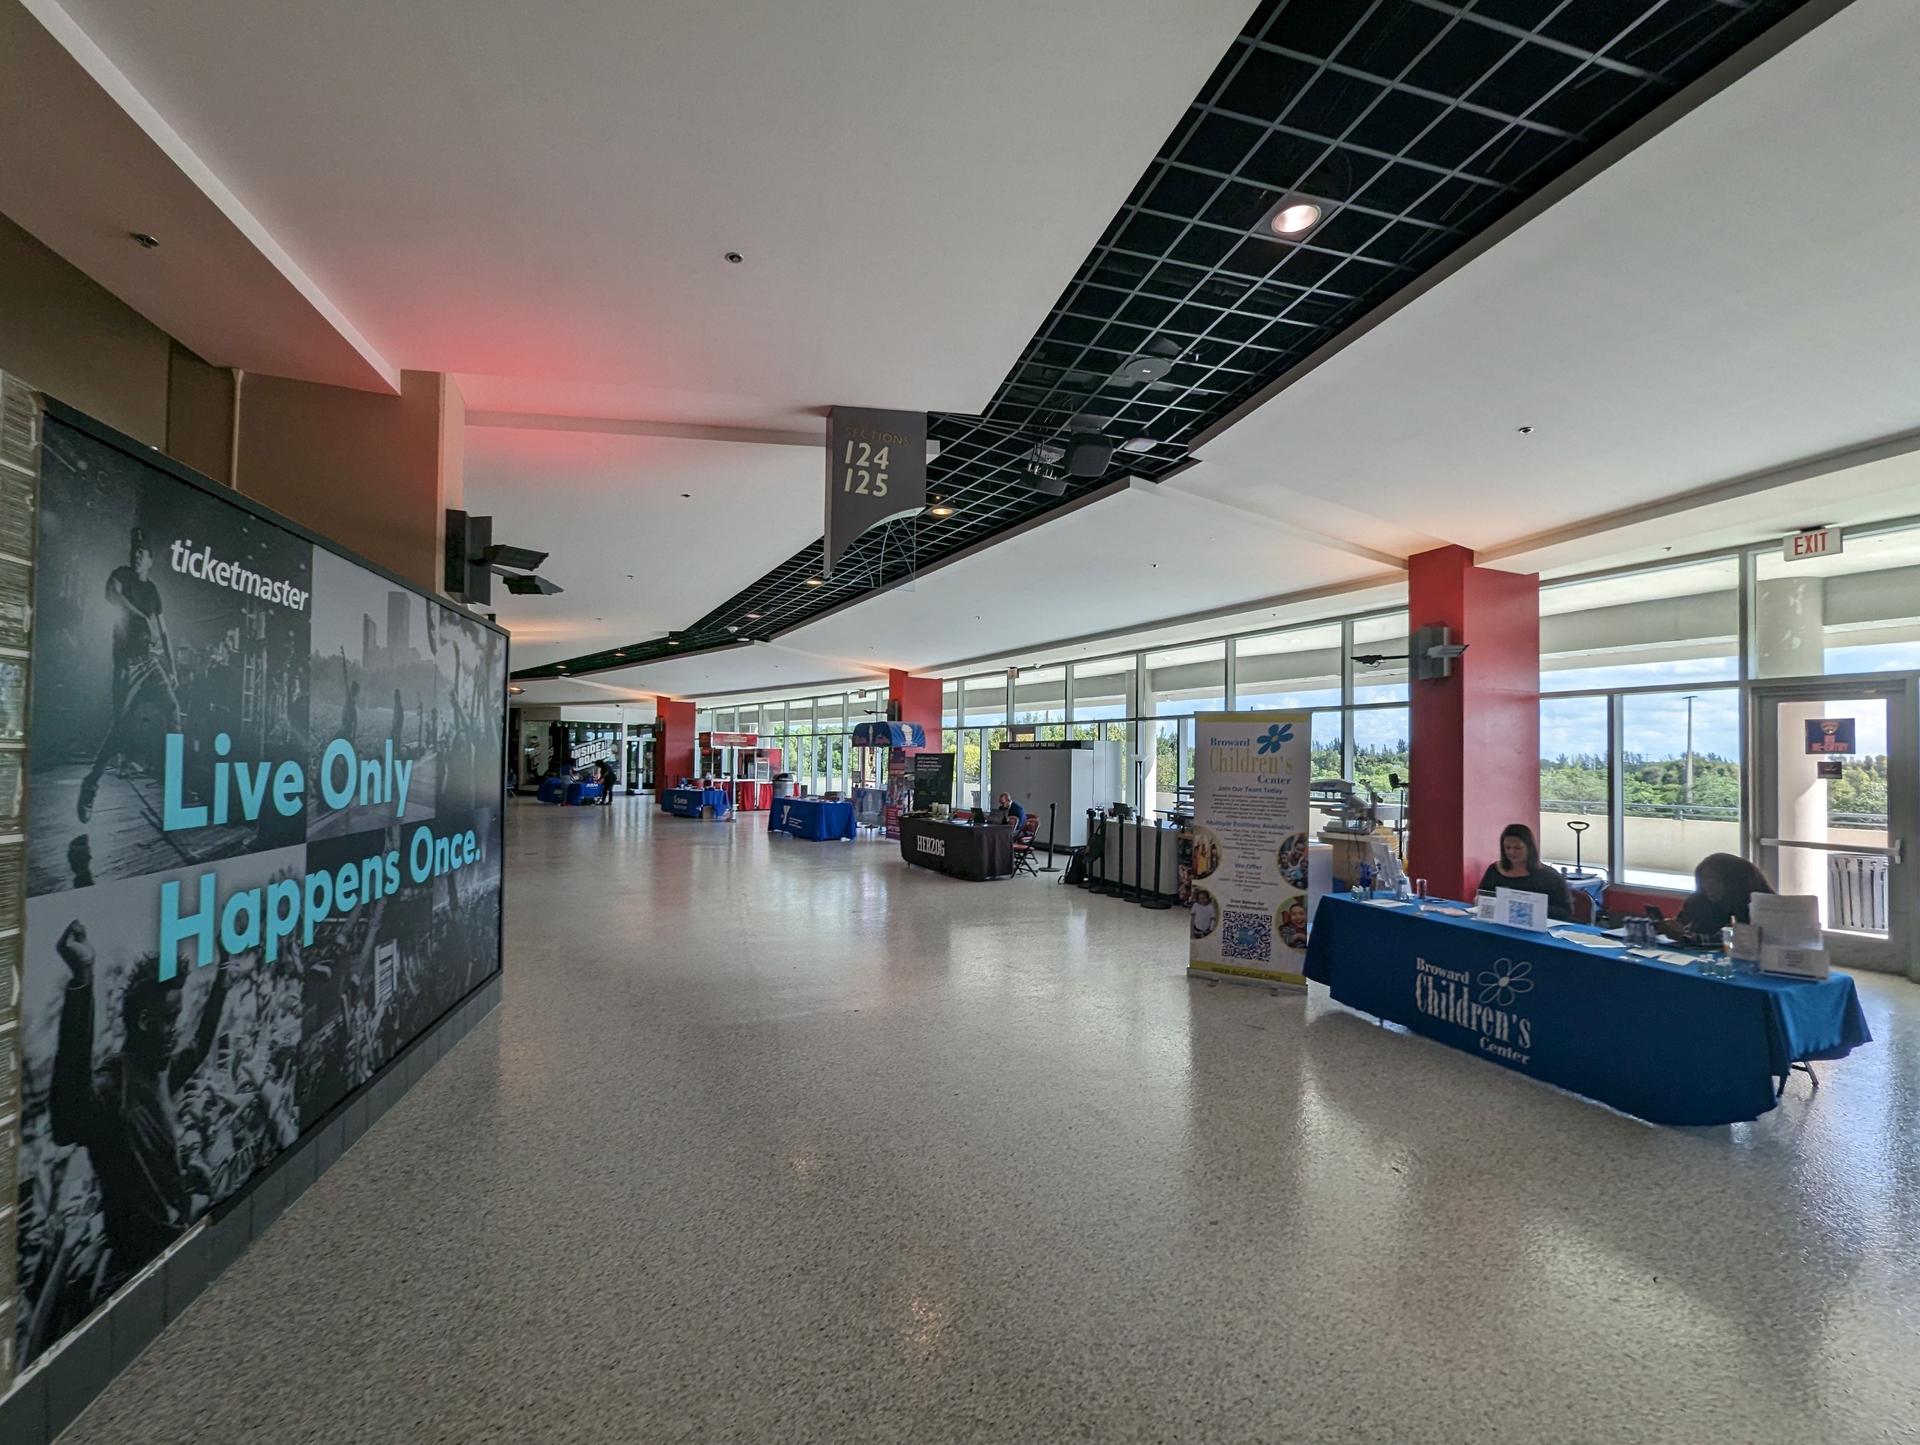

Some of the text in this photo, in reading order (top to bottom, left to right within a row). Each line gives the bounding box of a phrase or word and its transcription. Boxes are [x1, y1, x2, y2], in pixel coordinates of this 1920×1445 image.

[847, 425, 911, 447] SECTIONS
[844, 440, 889, 470] 124
[844, 468, 888, 497] 125
[1794, 532, 1828, 555] EXIT
[170, 539, 309, 611] ticketmaster
[571, 741, 602, 759] INSIDE
[1210, 737, 1250, 747] Broward
[578, 748, 611, 767] BOARDS
[1210, 748, 1295, 774] Children's
[163, 733, 413, 832] Live Only
[1257, 775, 1292, 785] Center
[917, 835, 945, 856] HERZOG
[158, 825, 481, 983] Happens Once.
[1416, 957, 1470, 985] Broward
[1415, 972, 1531, 1049] Children's
[1480, 1036, 1530, 1064] Center
